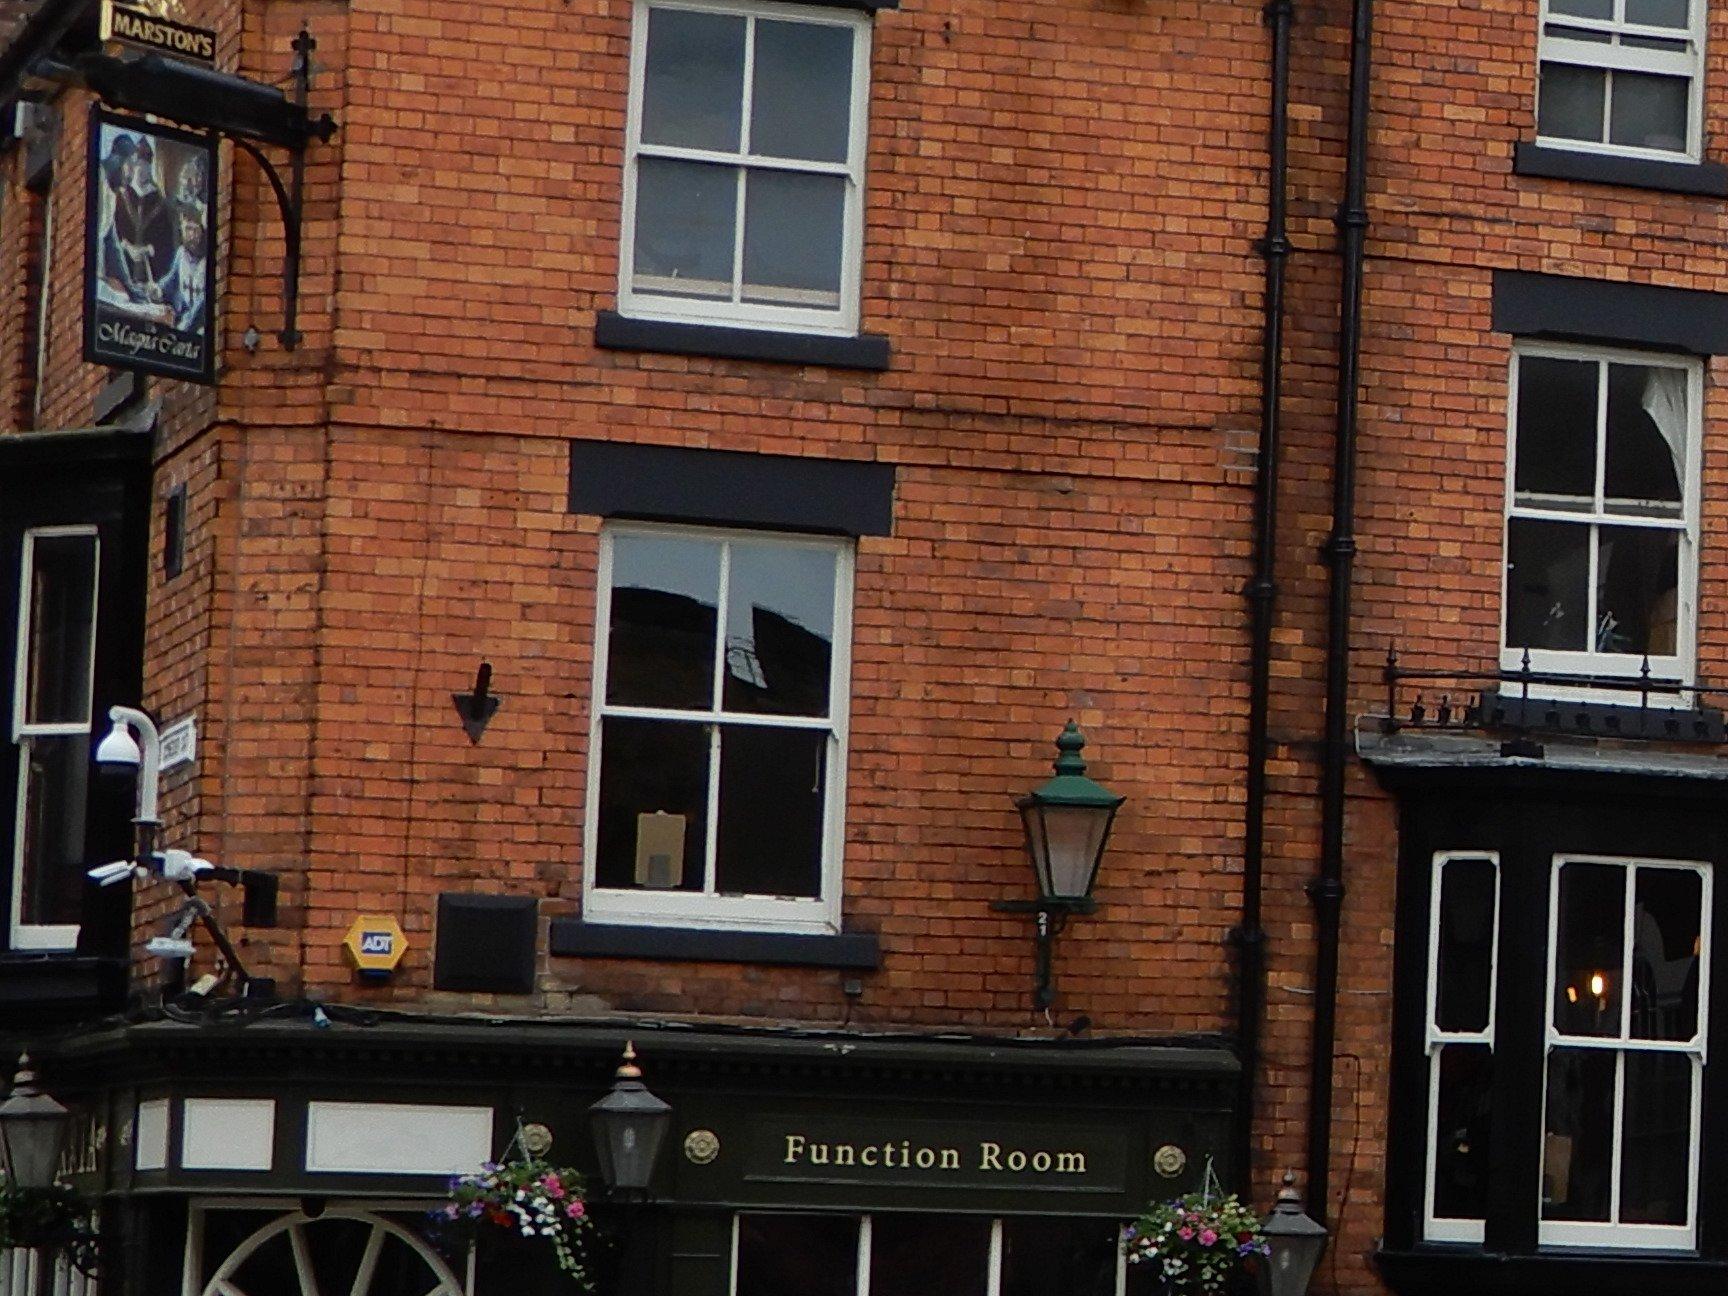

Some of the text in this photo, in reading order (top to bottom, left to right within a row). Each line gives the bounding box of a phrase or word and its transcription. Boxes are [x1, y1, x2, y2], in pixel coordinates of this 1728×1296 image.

[115, 13, 213, 57] MARSTON'S
[362, 935, 392, 951] ADT
[783, 1135, 1087, 1173] Function Room
